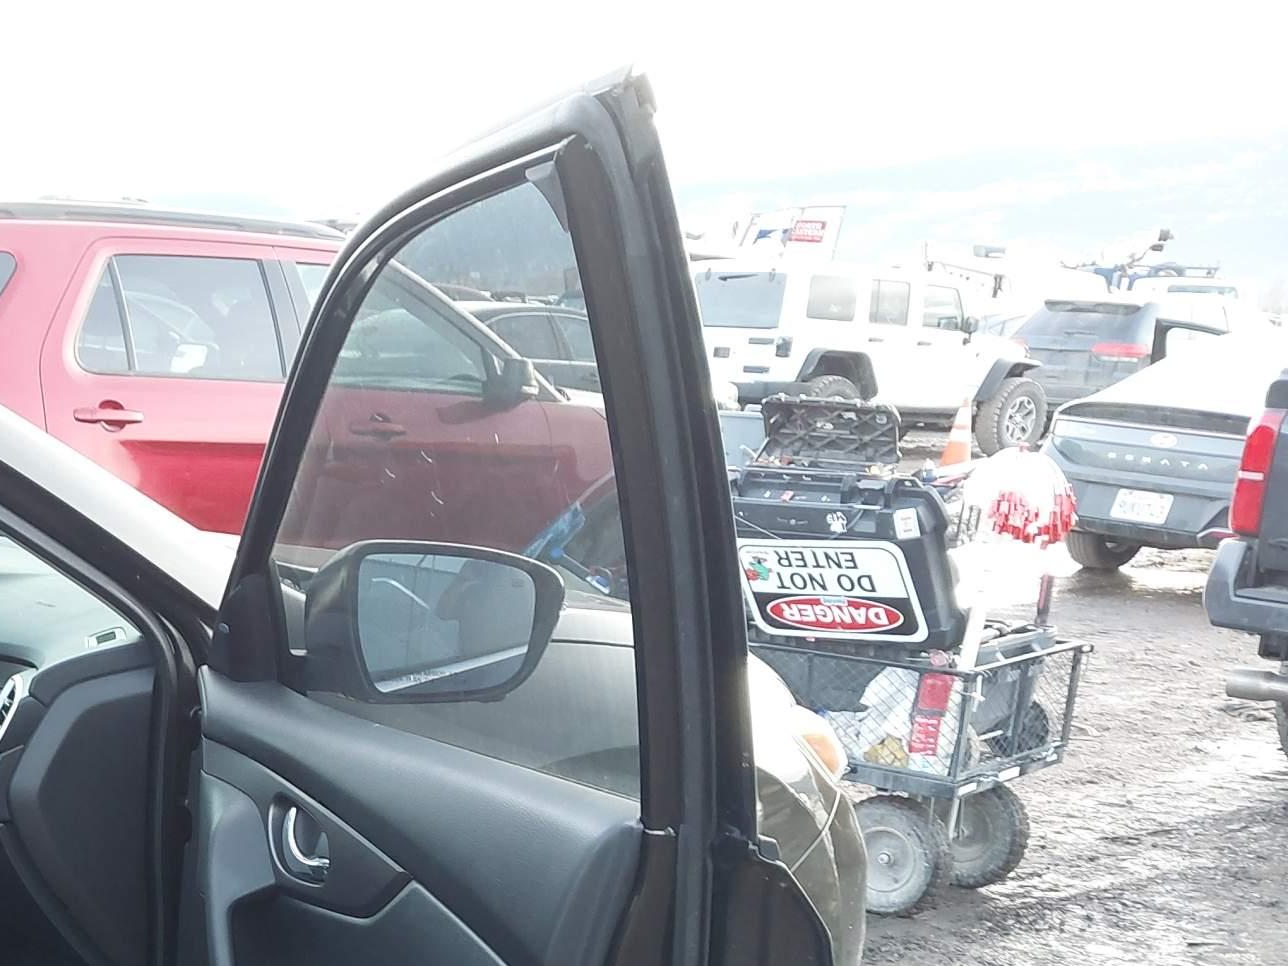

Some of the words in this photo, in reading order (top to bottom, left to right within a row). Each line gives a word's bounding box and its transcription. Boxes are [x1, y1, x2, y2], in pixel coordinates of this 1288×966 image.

[1107, 451, 1208, 470] SONATA
[773, 549, 859, 570] ENTER
[776, 571, 829, 592] NOT
[837, 573, 877, 593] DO
[779, 603, 890, 626] DANGER
